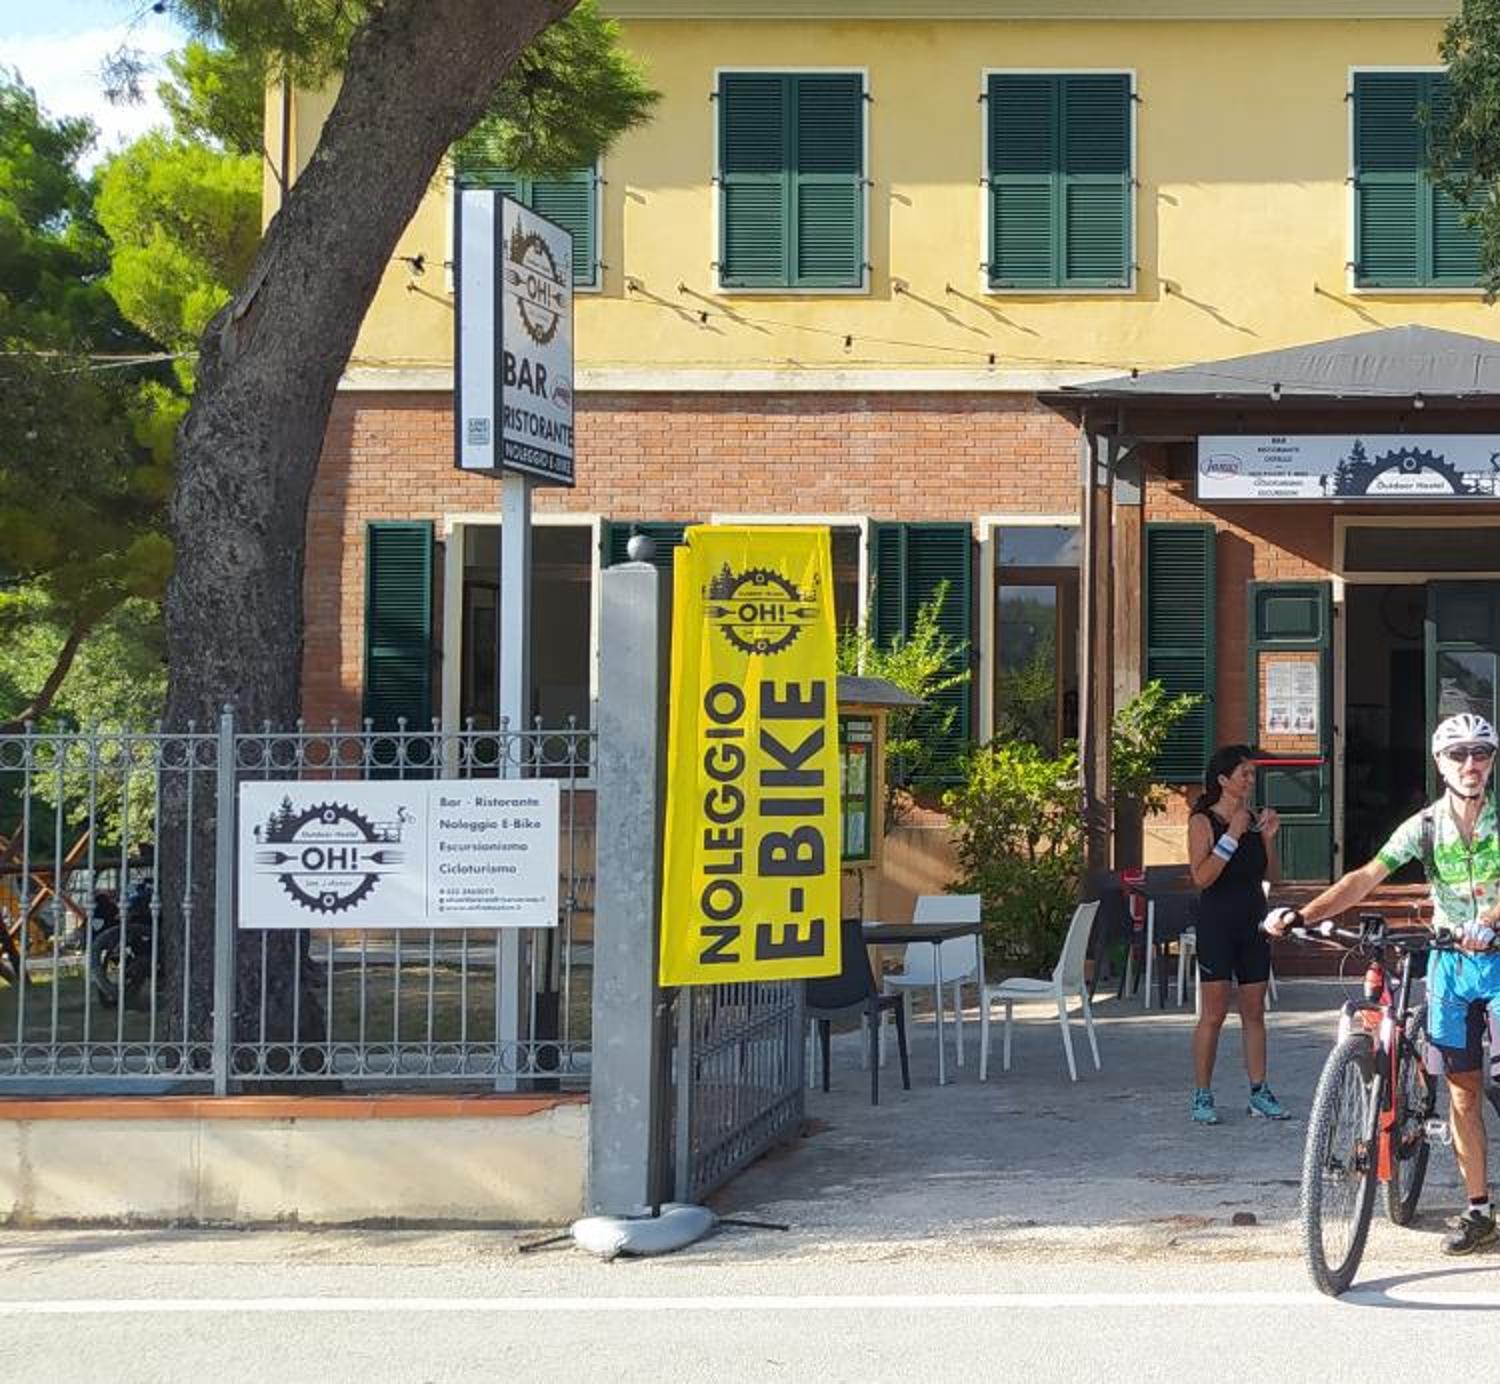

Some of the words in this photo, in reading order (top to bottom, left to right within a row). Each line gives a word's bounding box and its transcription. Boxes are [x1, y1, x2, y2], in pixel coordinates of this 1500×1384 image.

[527, 275, 551, 307] OH!
[503, 351, 547, 399] BAR
[503, 405, 573, 449] RISTORANTE
[505, 443, 548, 468] NOLEGGIO
[738, 603, 785, 623] OH!
[439, 797, 461, 807] Bar
[475, 796, 540, 807] Ristorante
[439, 819, 498, 832] Noleggio
[502, 818, 542, 829] E-Bike
[700, 682, 746, 965] NOLEGGIO
[755, 680, 826, 961] E-BIKE
[301, 846, 358, 871] OH!
[439, 841, 529, 851] Escursionismo
[439, 863, 517, 874] Cicloturismo
